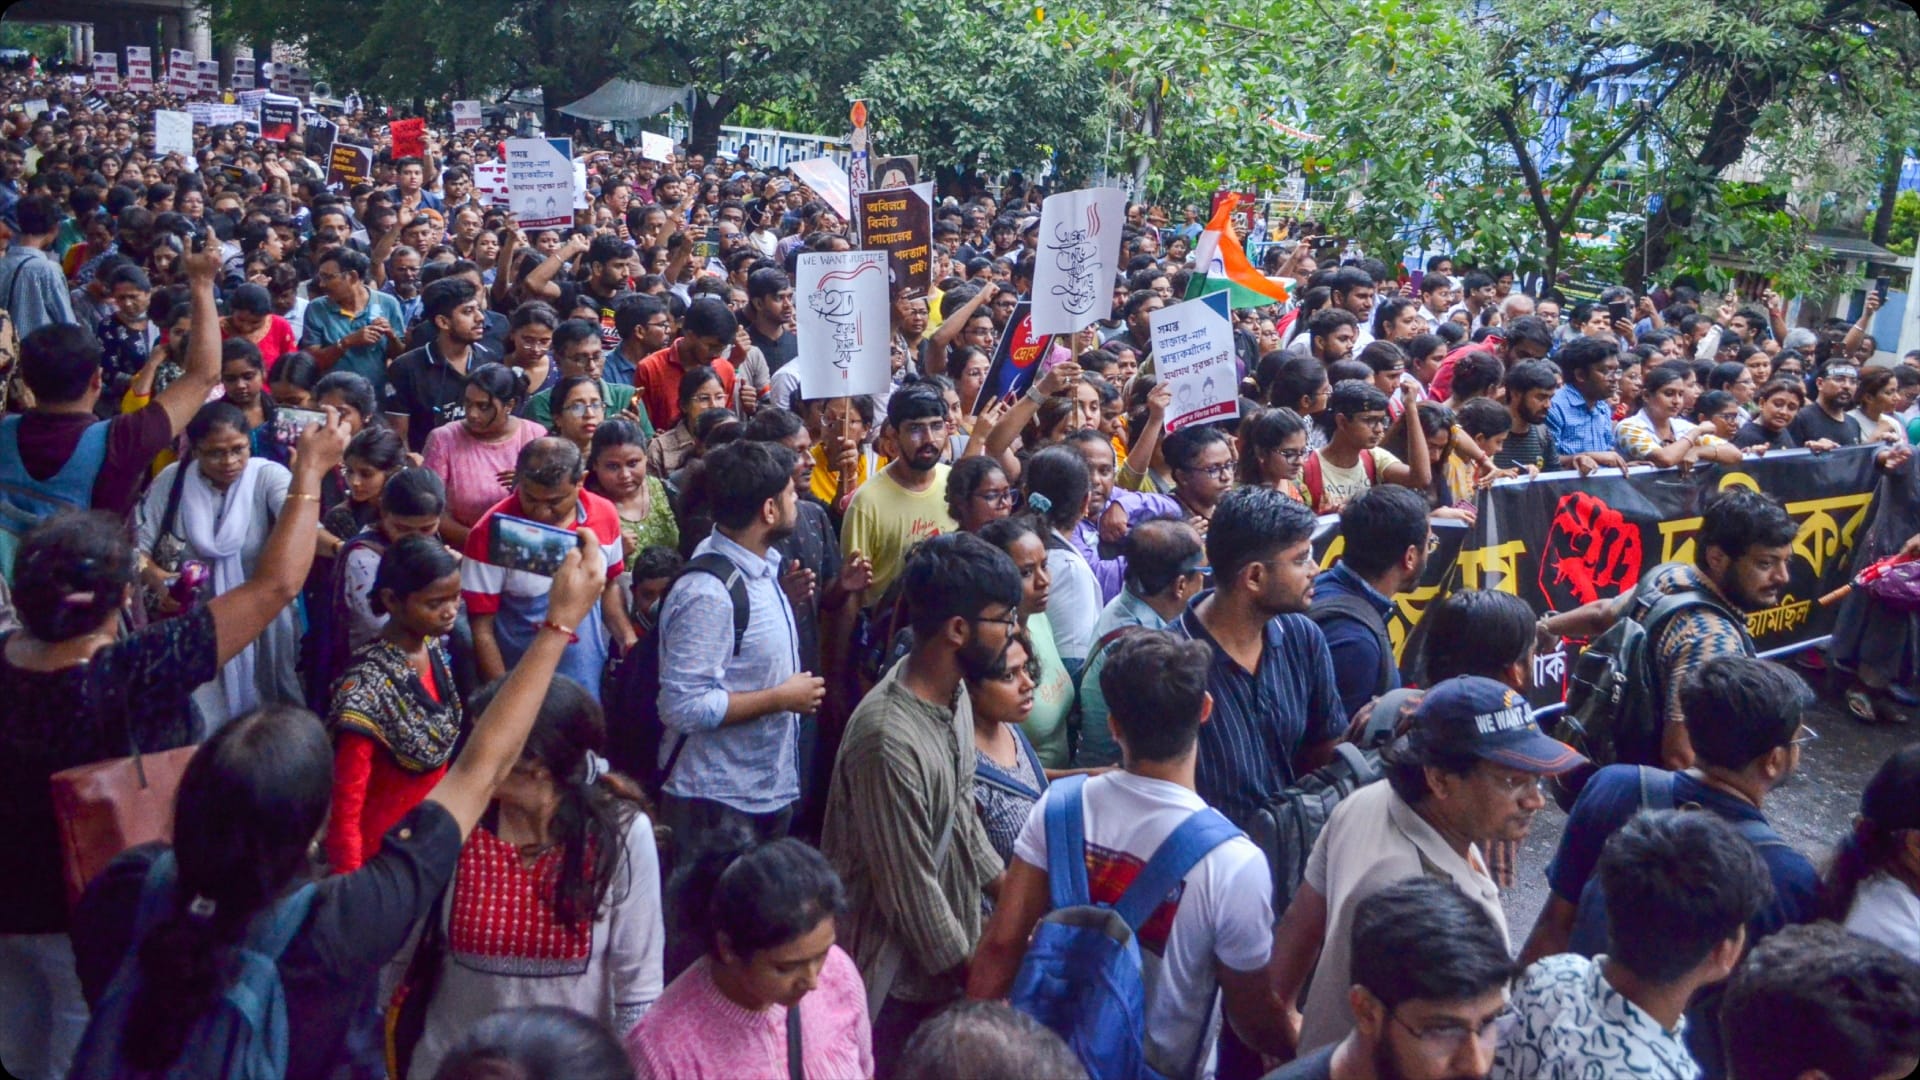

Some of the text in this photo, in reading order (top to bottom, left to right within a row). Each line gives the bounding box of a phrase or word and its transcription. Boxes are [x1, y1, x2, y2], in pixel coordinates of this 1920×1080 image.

[803, 252, 885, 266] WE WANT JUSTICE
[1475, 713, 1496, 733] WE
[1494, 706, 1524, 730] WANT
